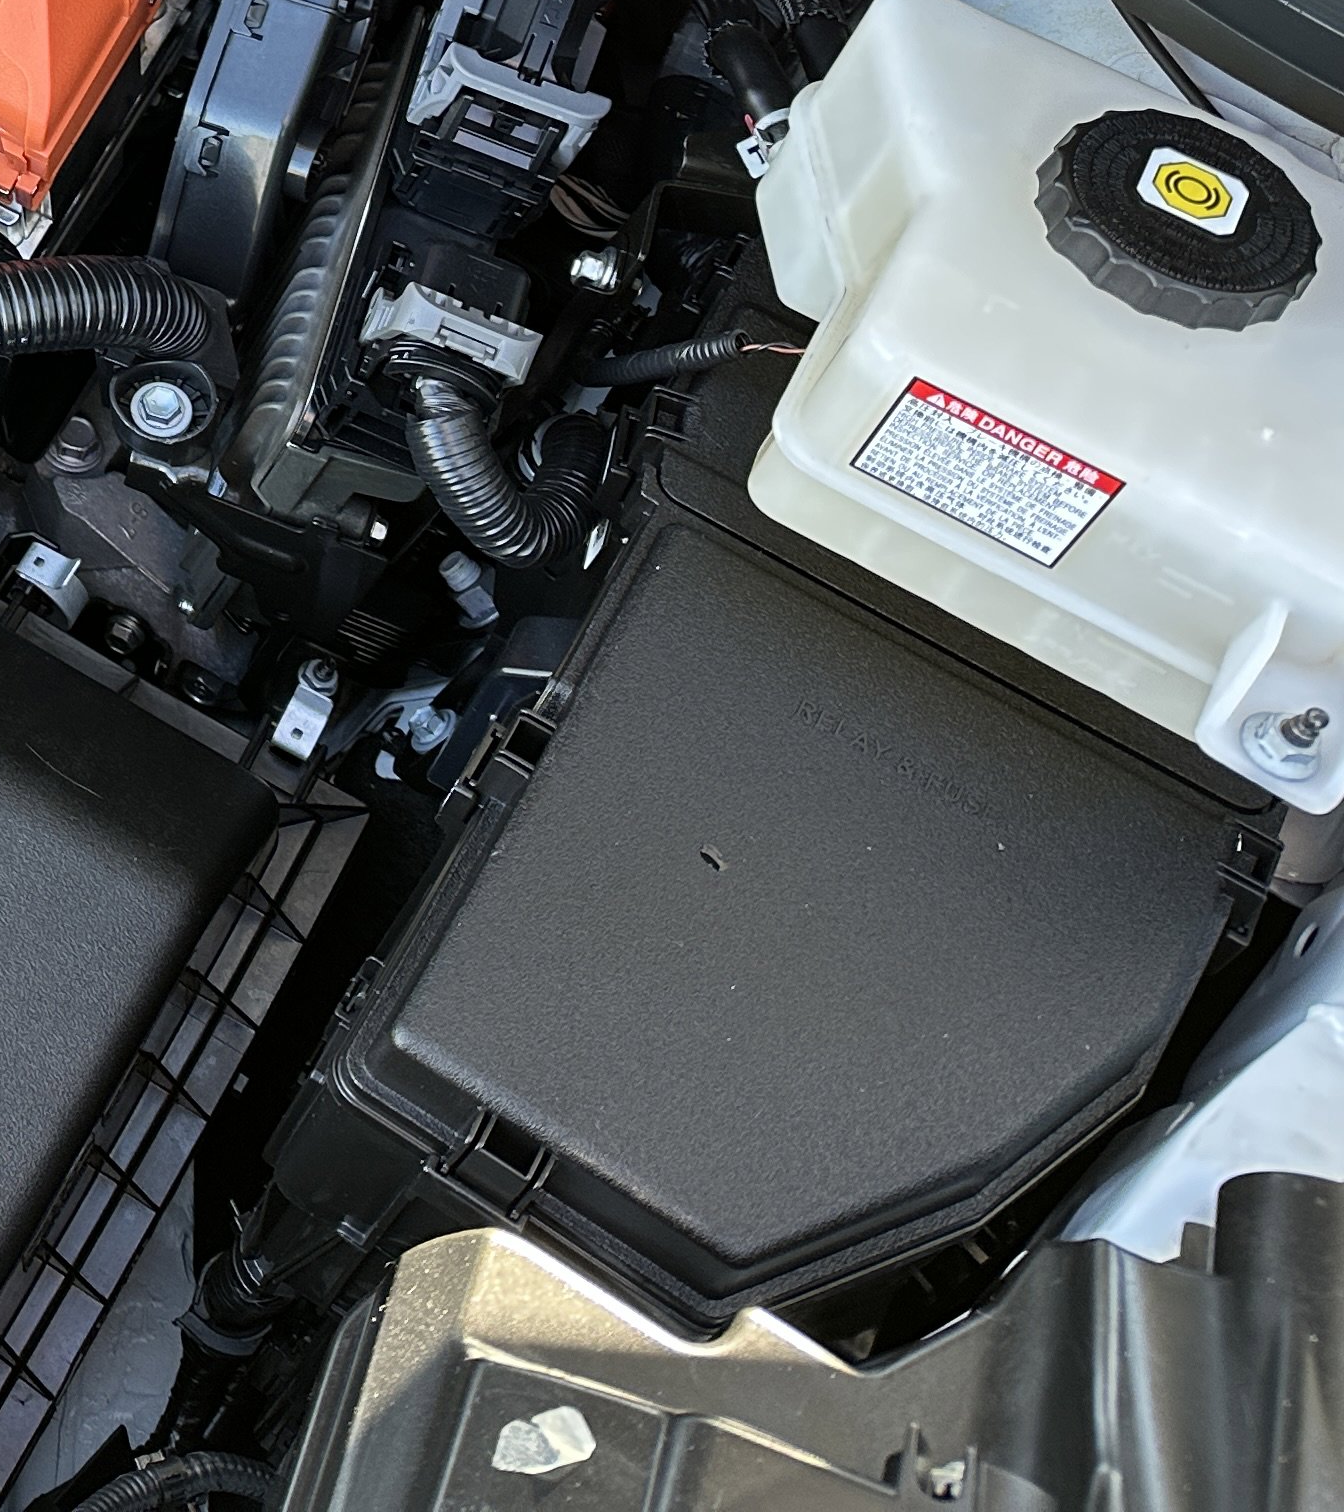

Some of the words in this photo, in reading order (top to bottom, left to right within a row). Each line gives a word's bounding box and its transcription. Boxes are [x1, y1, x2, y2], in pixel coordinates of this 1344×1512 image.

[976, 416, 1063, 465] DANGER
[792, 699, 893, 760] RELAY
[895, 754, 920, 780] &
